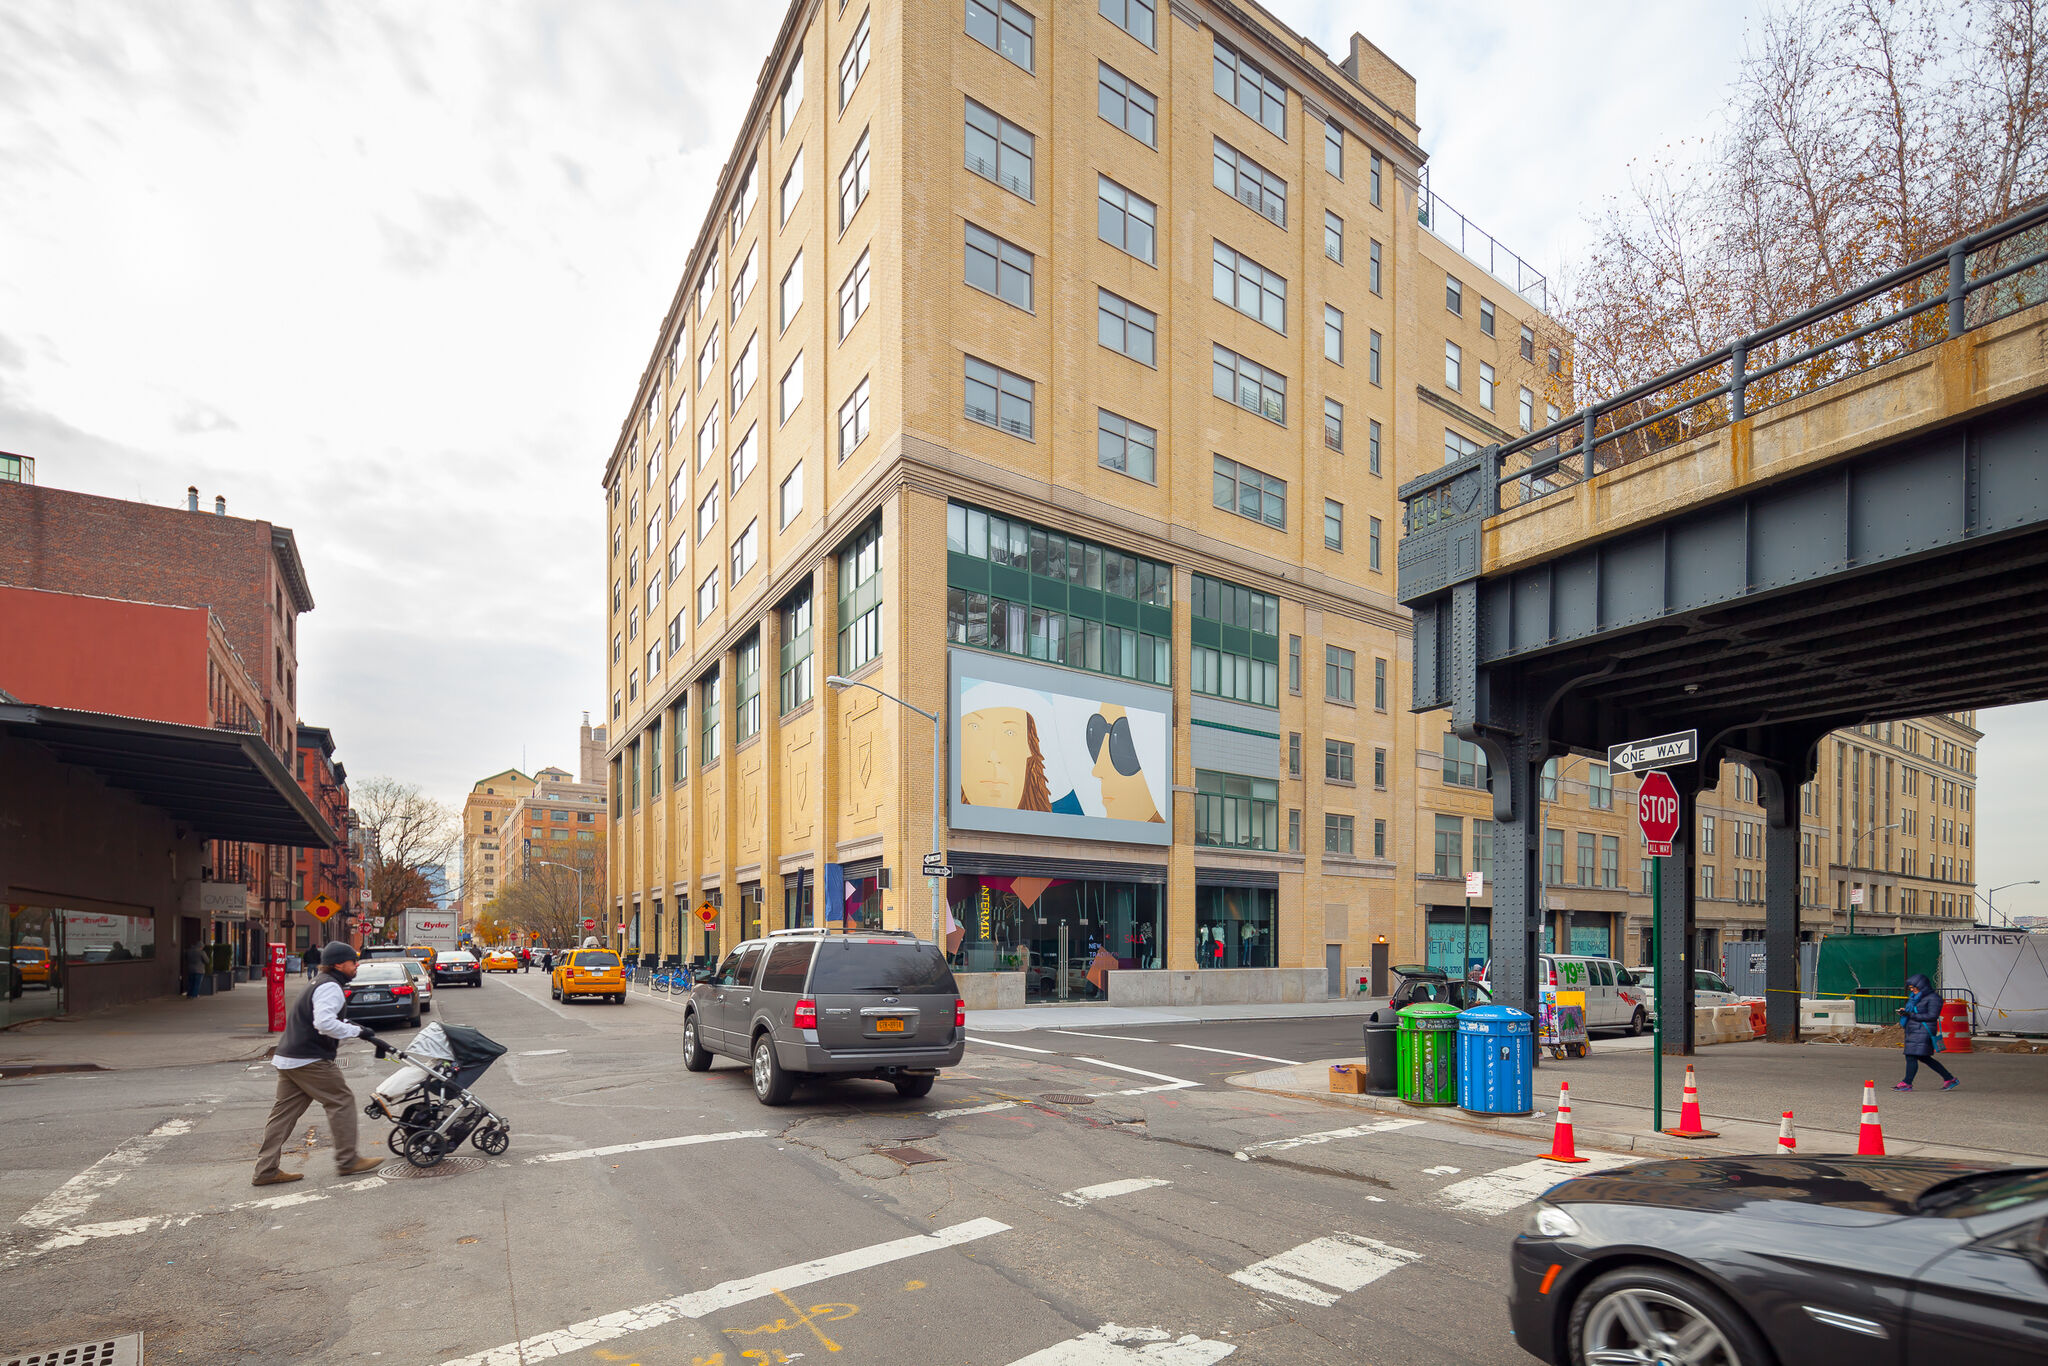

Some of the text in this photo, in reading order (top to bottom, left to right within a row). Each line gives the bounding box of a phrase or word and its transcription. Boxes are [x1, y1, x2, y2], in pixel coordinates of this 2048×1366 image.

[1622, 742, 1684, 764] ONE WAY
[1641, 794, 1676, 824] STOP
[1648, 842, 1670, 853] ALL WAY
[980, 885, 990, 939] INTERMIX
[423, 921, 449, 929] Ryder
[1124, 934, 1144, 944] SALE
[1446, 929, 1484, 938] GANSEOORT
[1952, 934, 2024, 945] WHITNEY
[1456, 941, 1485, 954] SPACE
[1570, 941, 1607, 951] ETAIL SPACE
